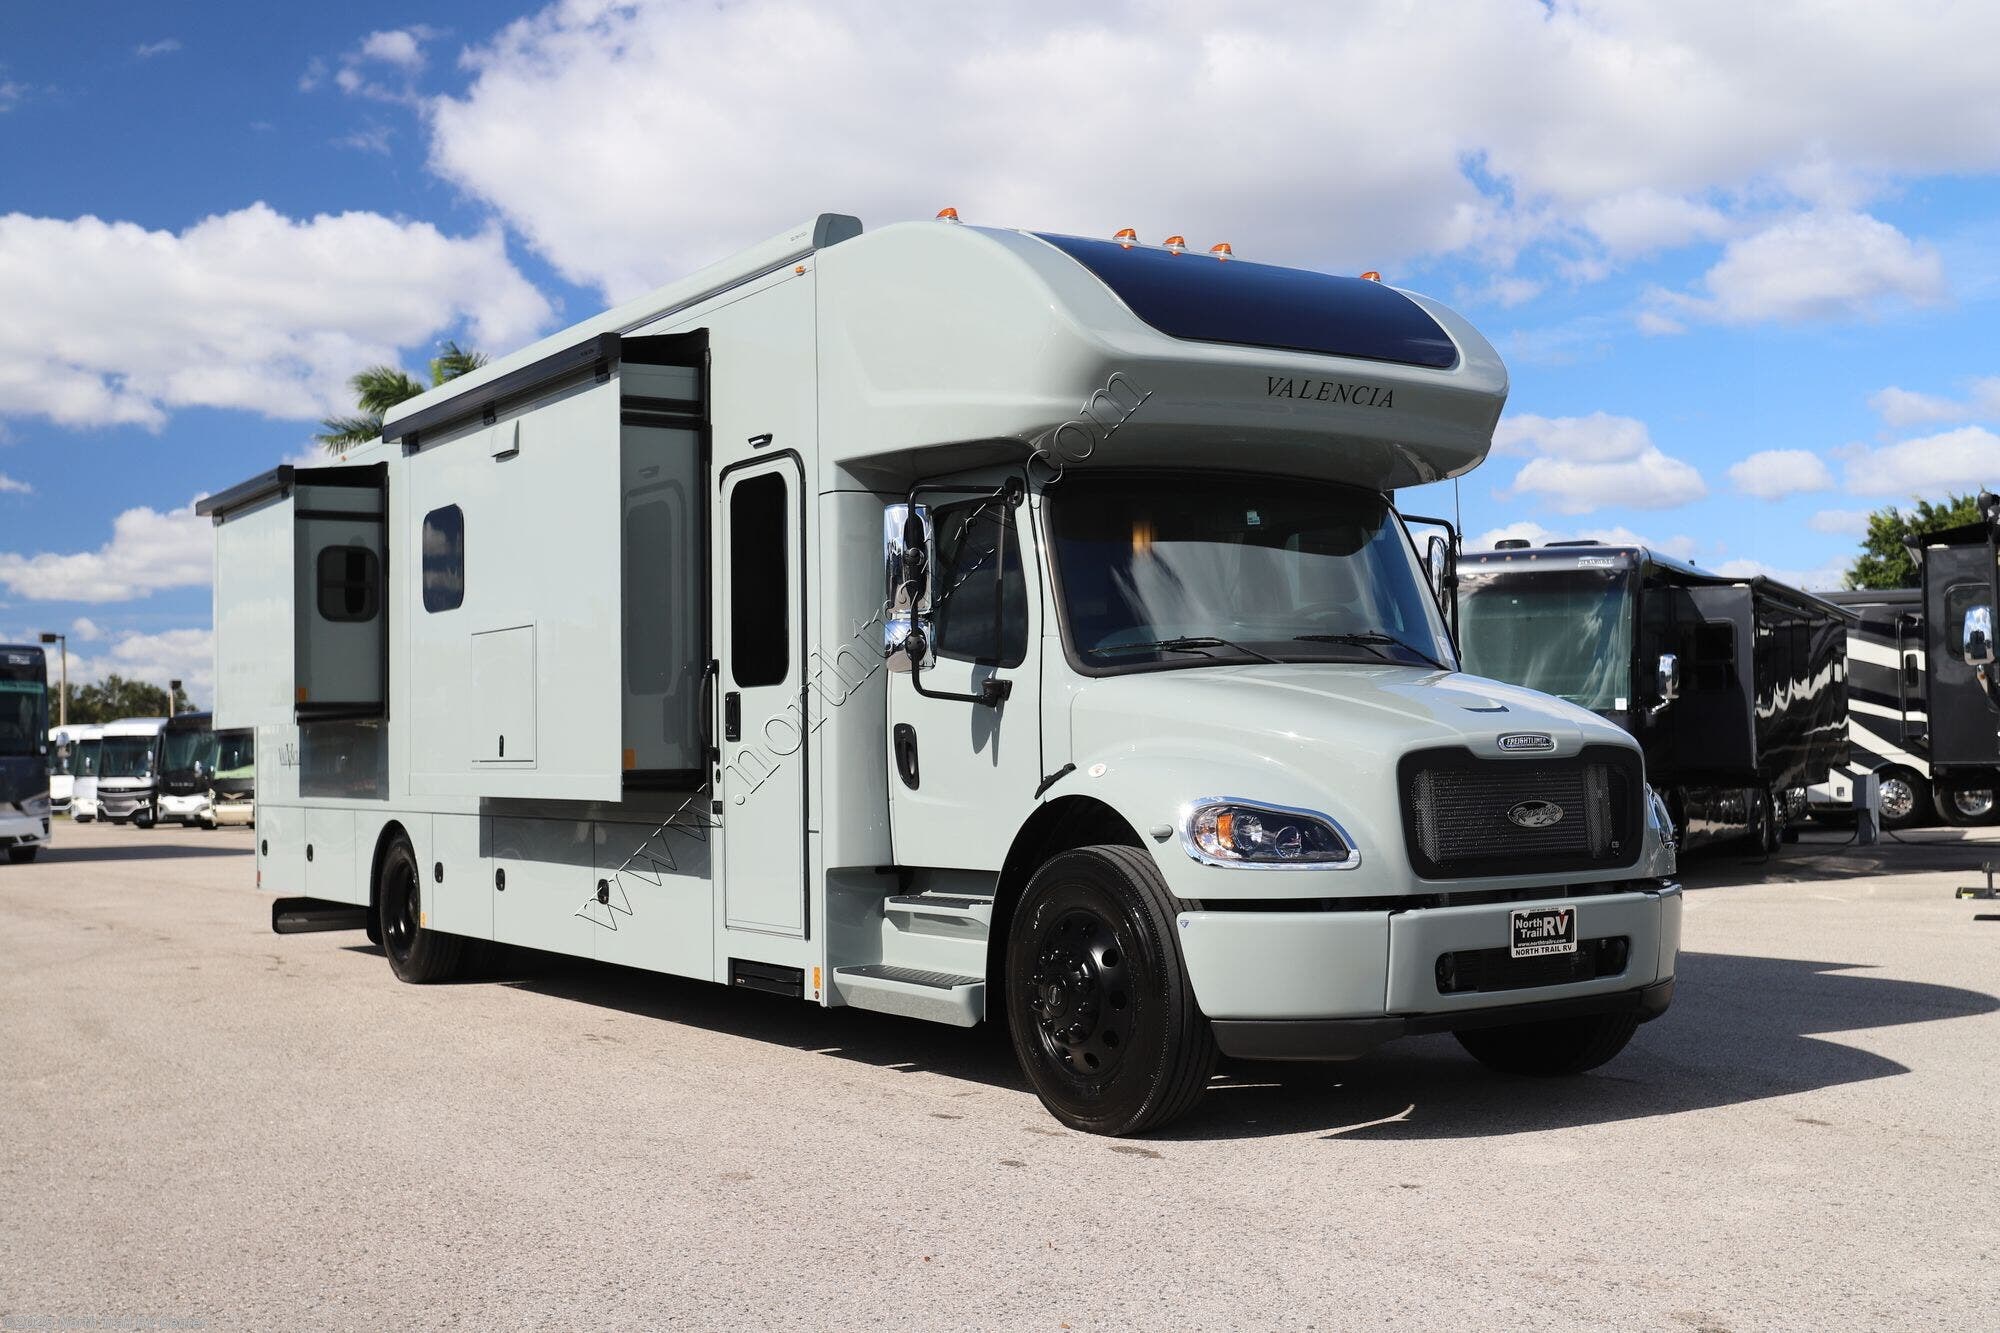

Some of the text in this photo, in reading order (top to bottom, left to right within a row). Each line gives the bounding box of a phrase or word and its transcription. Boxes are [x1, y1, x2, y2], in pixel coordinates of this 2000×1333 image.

[1267, 376, 1393, 409] VALENCIA
[1515, 915, 1569, 937] North RV
[1521, 928, 1542, 938] Trail
[1515, 947, 1539, 956] NORTH
[1562, 944, 1573, 952] RV
